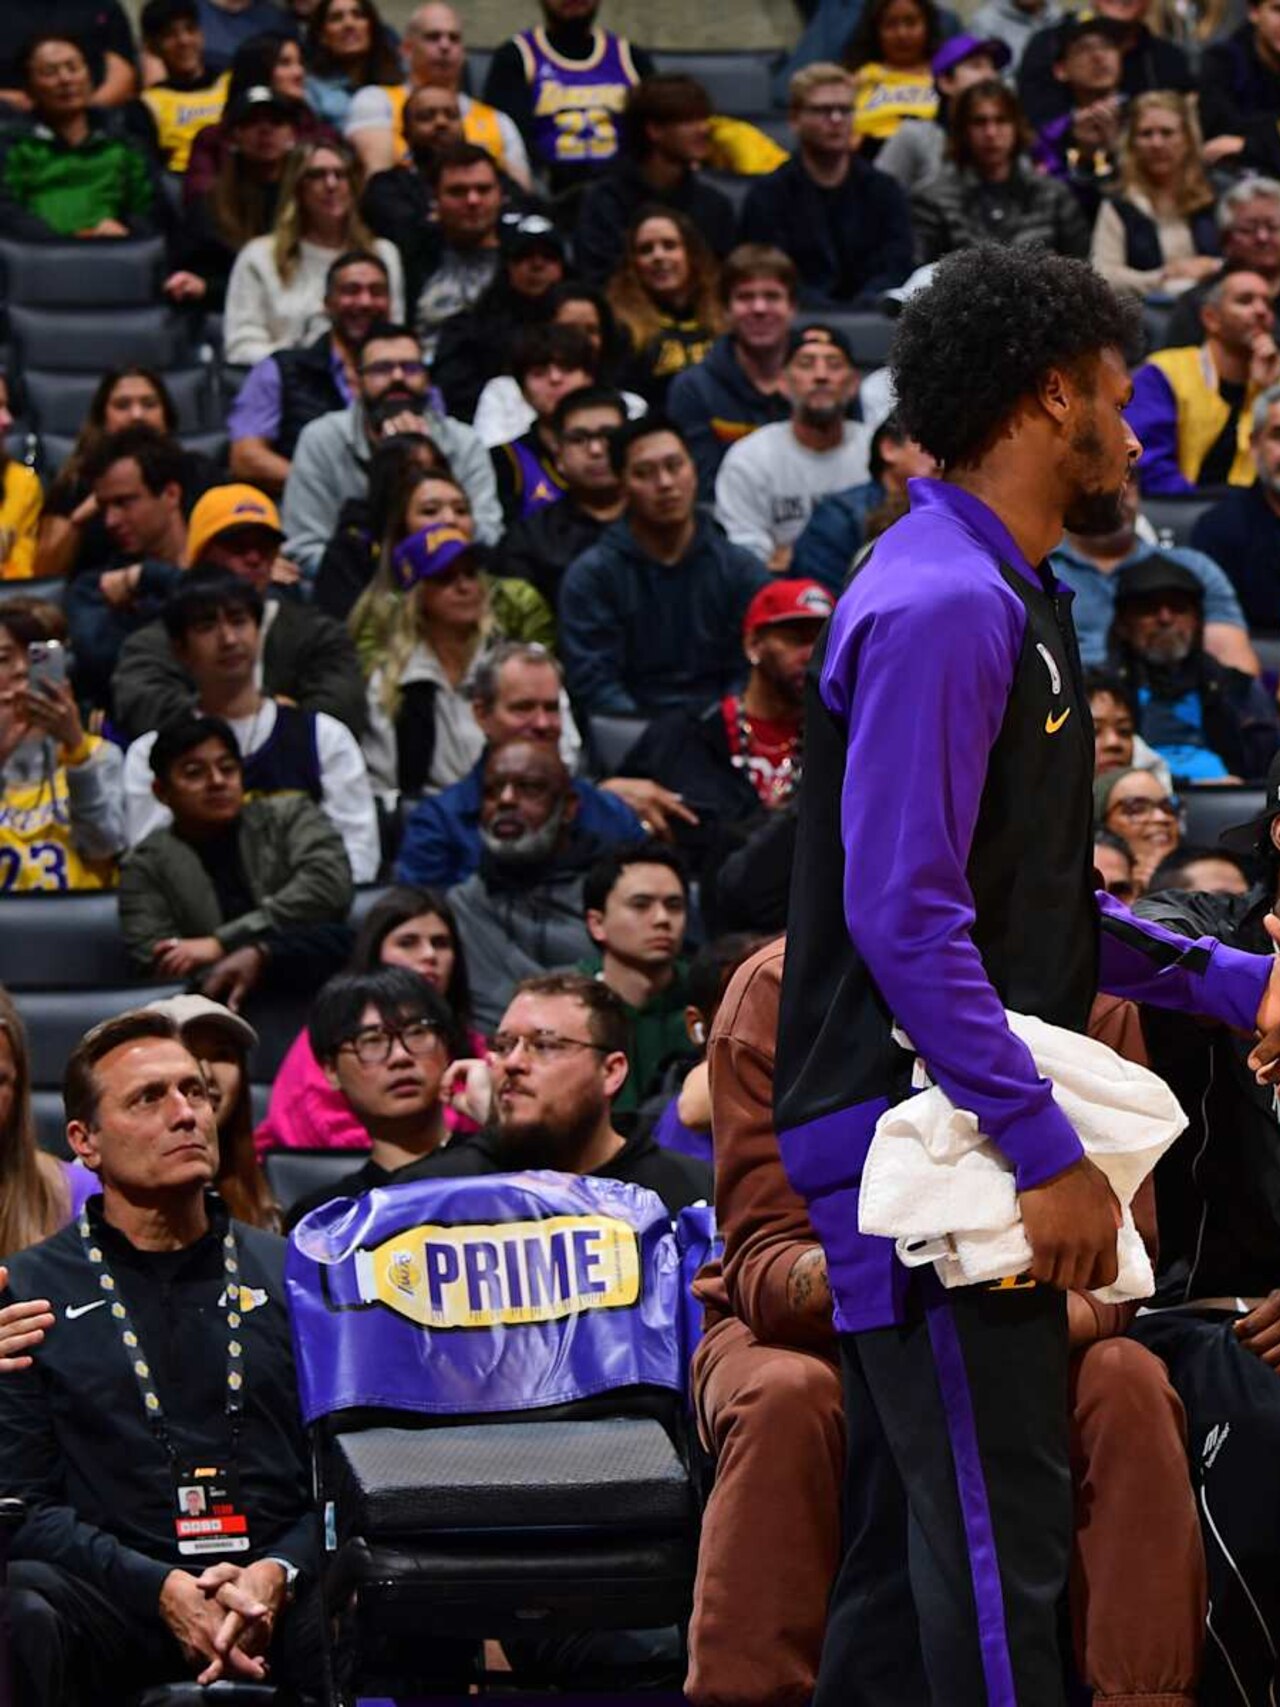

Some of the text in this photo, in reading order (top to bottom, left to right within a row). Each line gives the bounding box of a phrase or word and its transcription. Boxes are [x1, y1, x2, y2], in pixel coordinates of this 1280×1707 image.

[554, 110, 618, 160] 23
[0, 841, 69, 892] 23
[424, 1229, 607, 1312] PRIME
